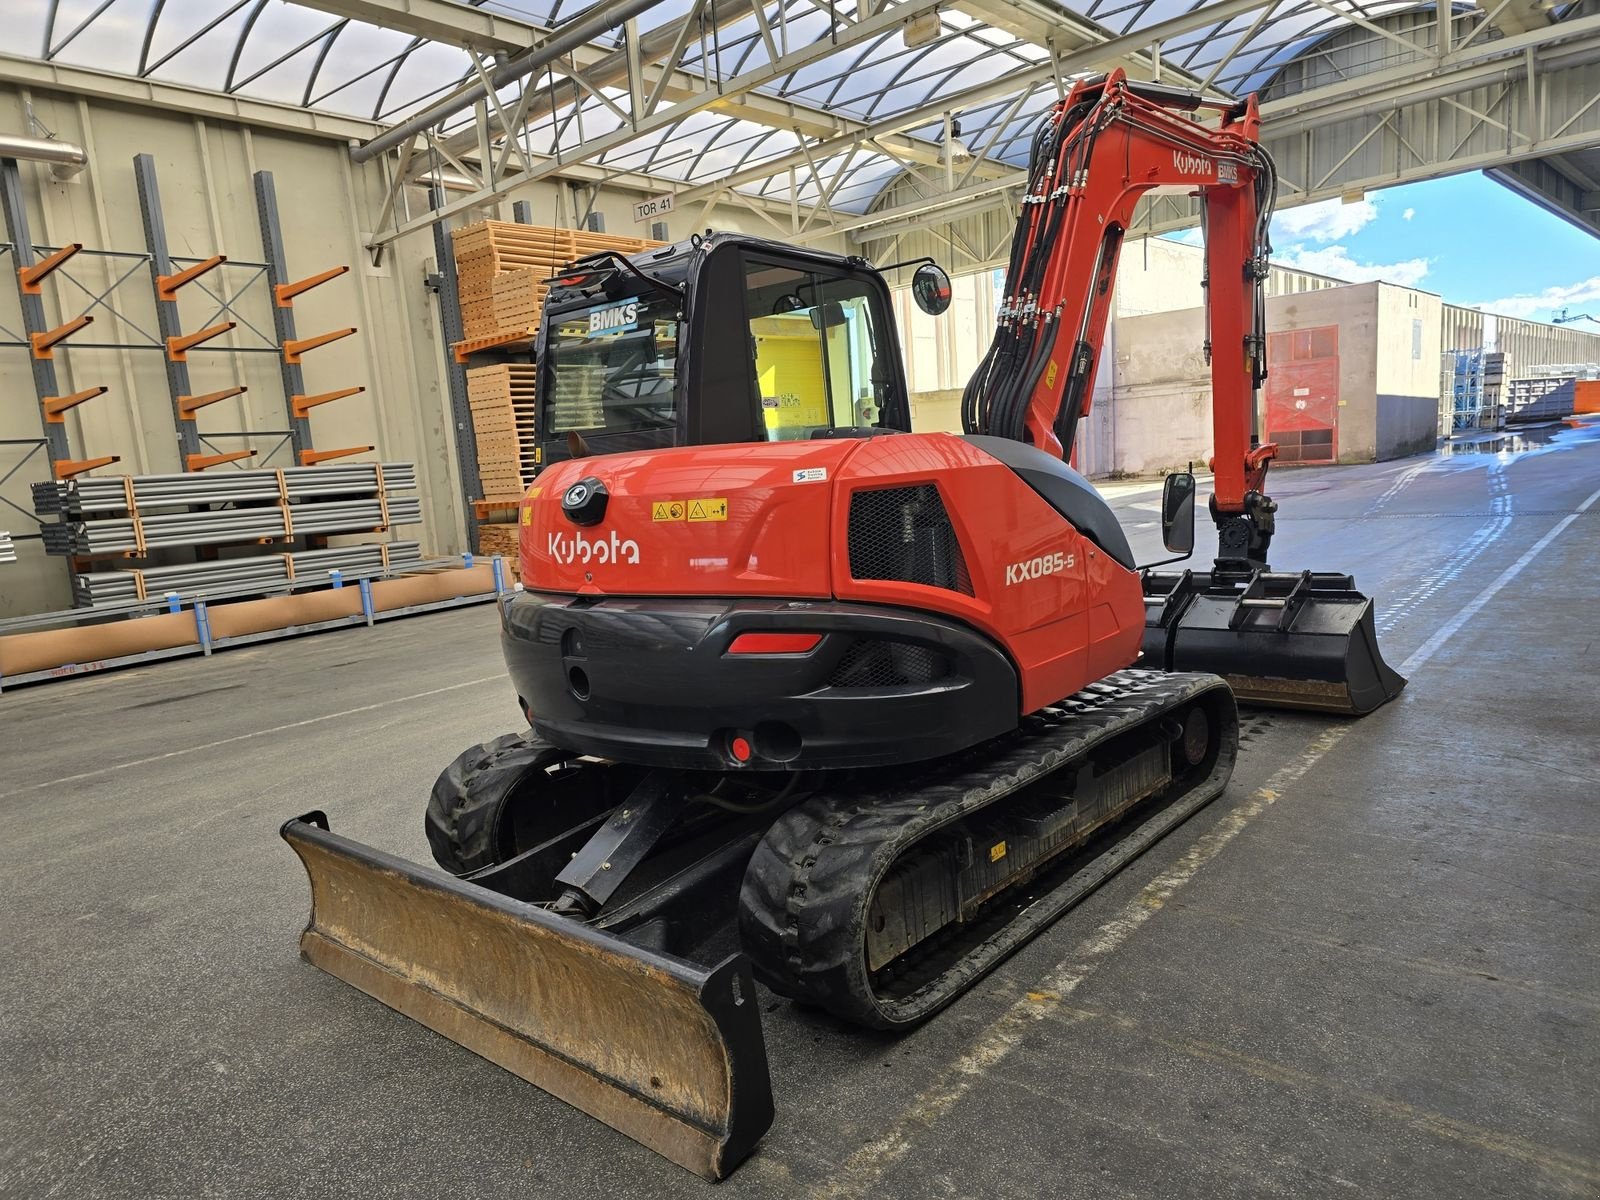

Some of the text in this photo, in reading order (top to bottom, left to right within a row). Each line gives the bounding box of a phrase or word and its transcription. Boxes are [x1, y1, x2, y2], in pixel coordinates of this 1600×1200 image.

[1173, 150, 1212, 175] Kubota
[1217, 164, 1238, 180] BMKS
[638, 198, 671, 217] TOR 41
[590, 303, 637, 332] BMKS
[548, 530, 640, 564] Kubota
[1006, 551, 1074, 586] KX085-5
